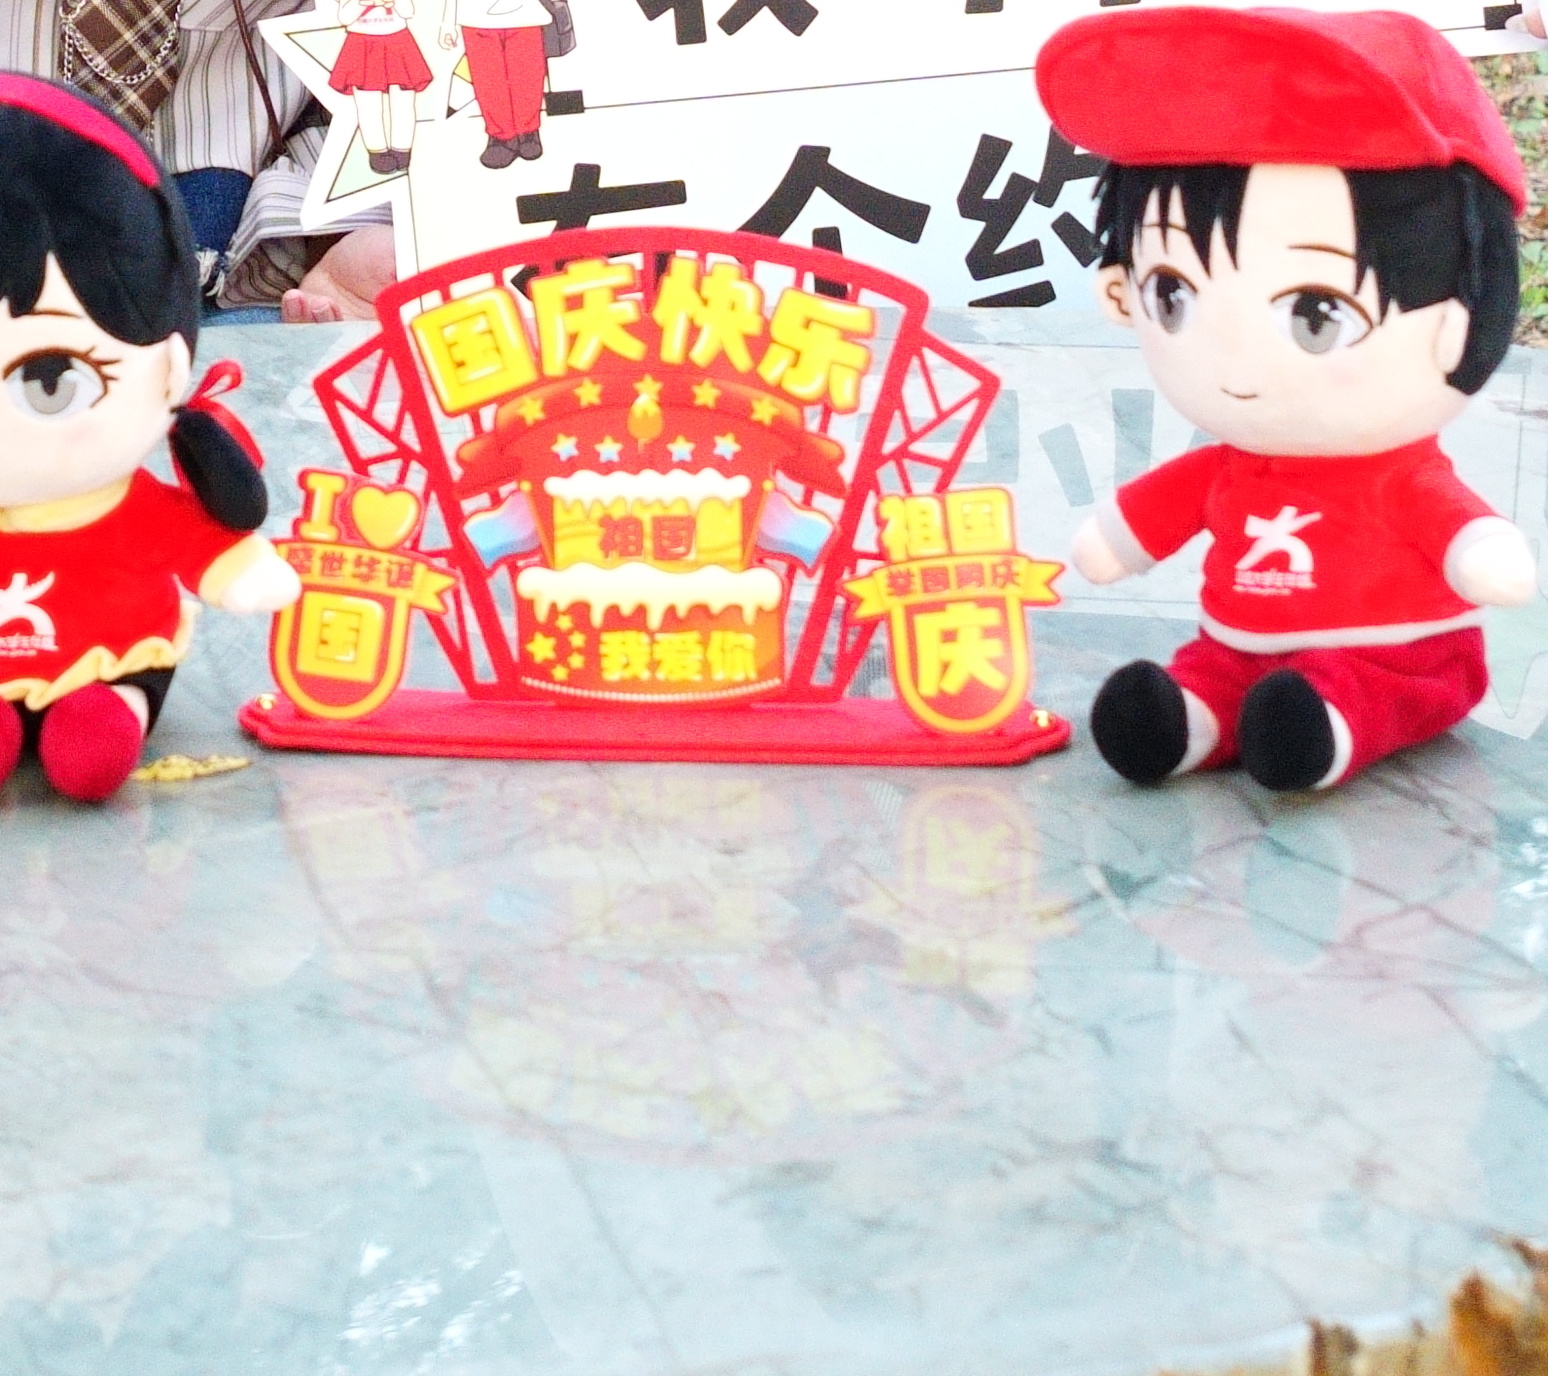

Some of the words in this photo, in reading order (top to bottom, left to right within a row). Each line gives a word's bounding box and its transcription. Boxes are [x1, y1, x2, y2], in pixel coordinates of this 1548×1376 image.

[410, 255, 874, 415] 国庆快乐
[598, 514, 697, 561] 祖国
[878, 487, 1015, 563] 祖国
[295, 590, 385, 684] 国
[599, 629, 758, 682] 我爱你
[912, 602, 1010, 697] 庆
